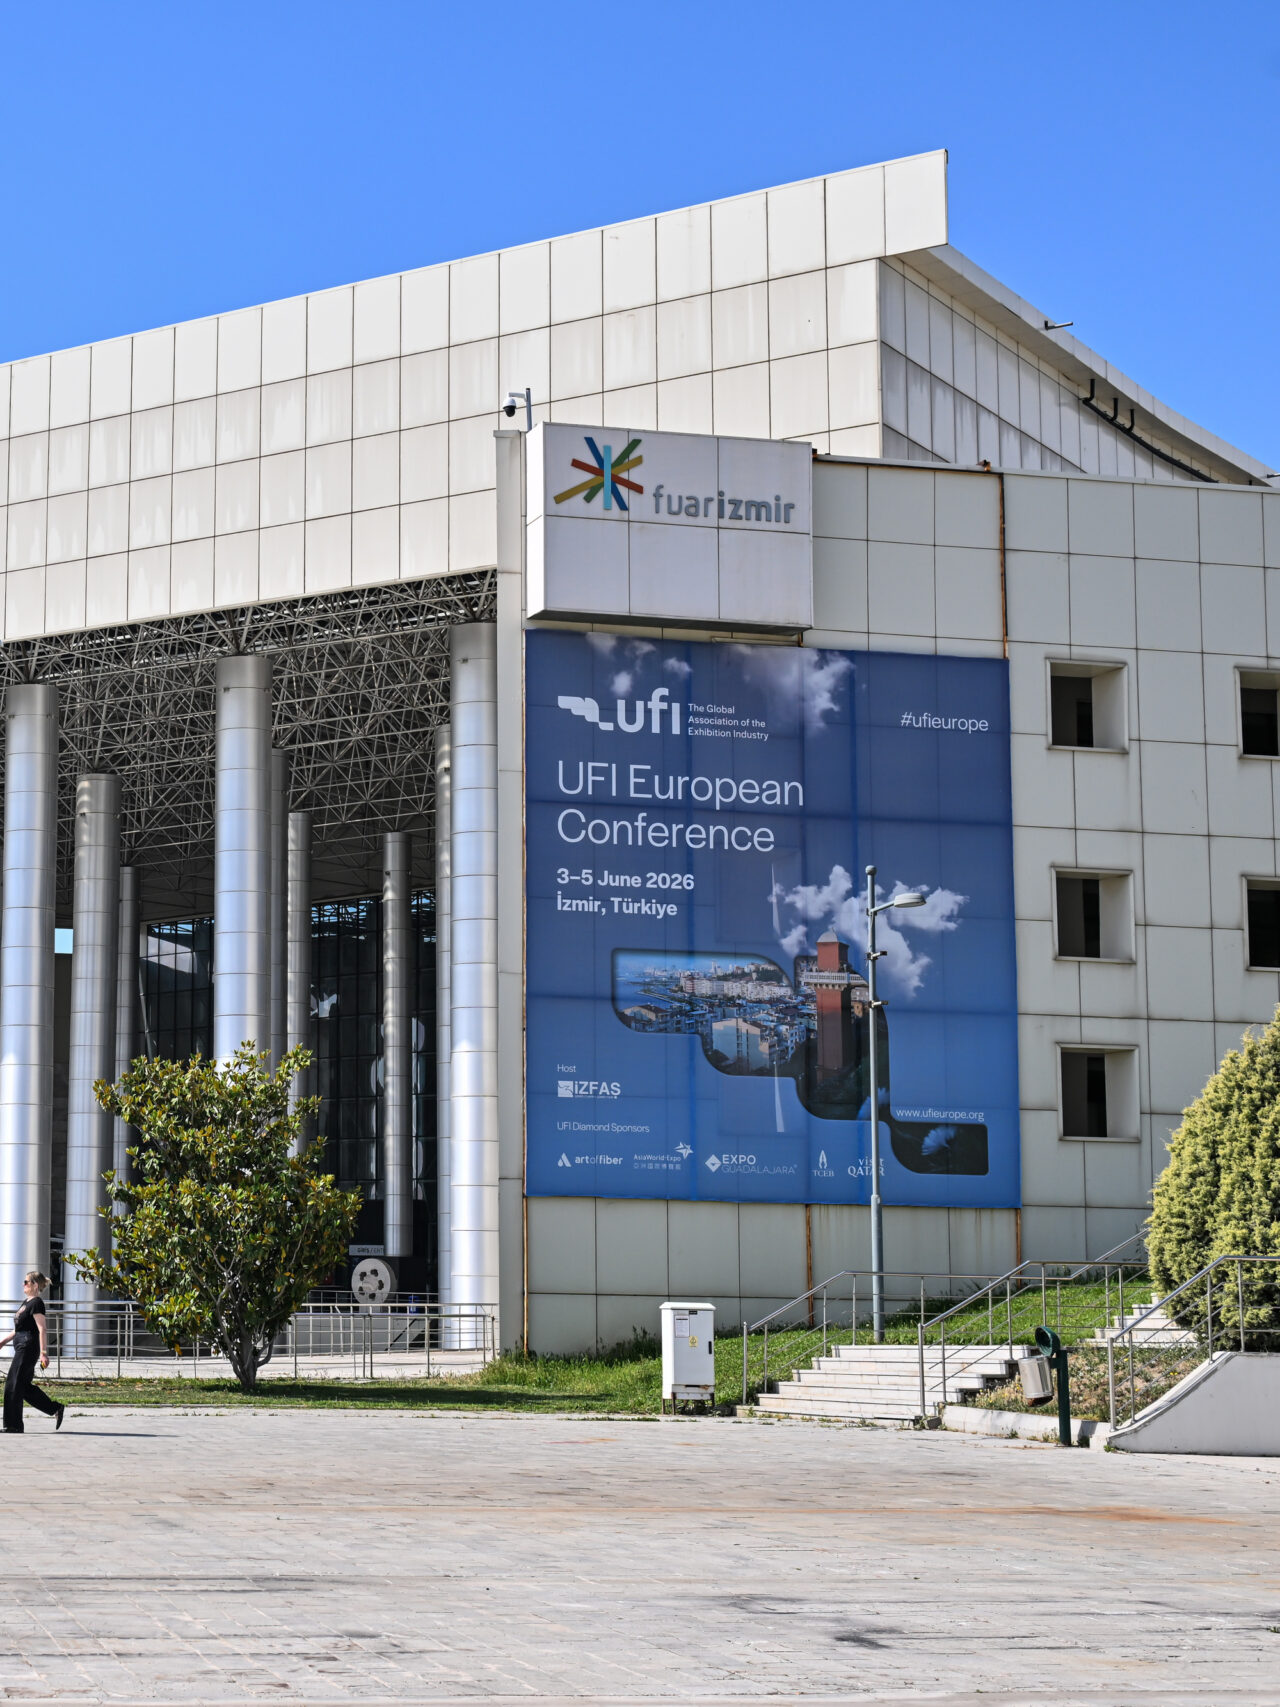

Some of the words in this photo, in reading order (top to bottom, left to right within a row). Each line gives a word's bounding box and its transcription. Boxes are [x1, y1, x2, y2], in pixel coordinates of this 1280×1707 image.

[653, 485, 795, 523] fuarizmir
[616, 687, 681, 735] ufi
[688, 703, 705, 712] The
[707, 704, 735, 714] Global
[688, 715, 739, 726] Association
[740, 719, 750, 727] of
[751, 719, 766, 728] the
[900, 711, 989, 734] #ufieurope
[688, 727, 732, 738] Exhibition
[733, 731, 769, 742] Industry
[558, 760, 617, 797] UFI
[629, 764, 804, 811] European
[557, 808, 775, 852] Conference
[598, 870, 642, 888] June
[645, 872, 695, 890] 2026
[556, 891, 606, 916] İzmir,
[610, 897, 678, 919] Türkiye
[557, 1064, 576, 1073] Host
[895, 1108, 985, 1122] www.ufieurope.org
[557, 1121, 572, 1131] UFI
[572, 1121, 610, 1132] Diamond
[610, 1123, 650, 1133] Sponsors
[722, 1154, 757, 1165] EXPO
[858, 1156, 885, 1167] vist
[847, 1165, 886, 1178] QATR
